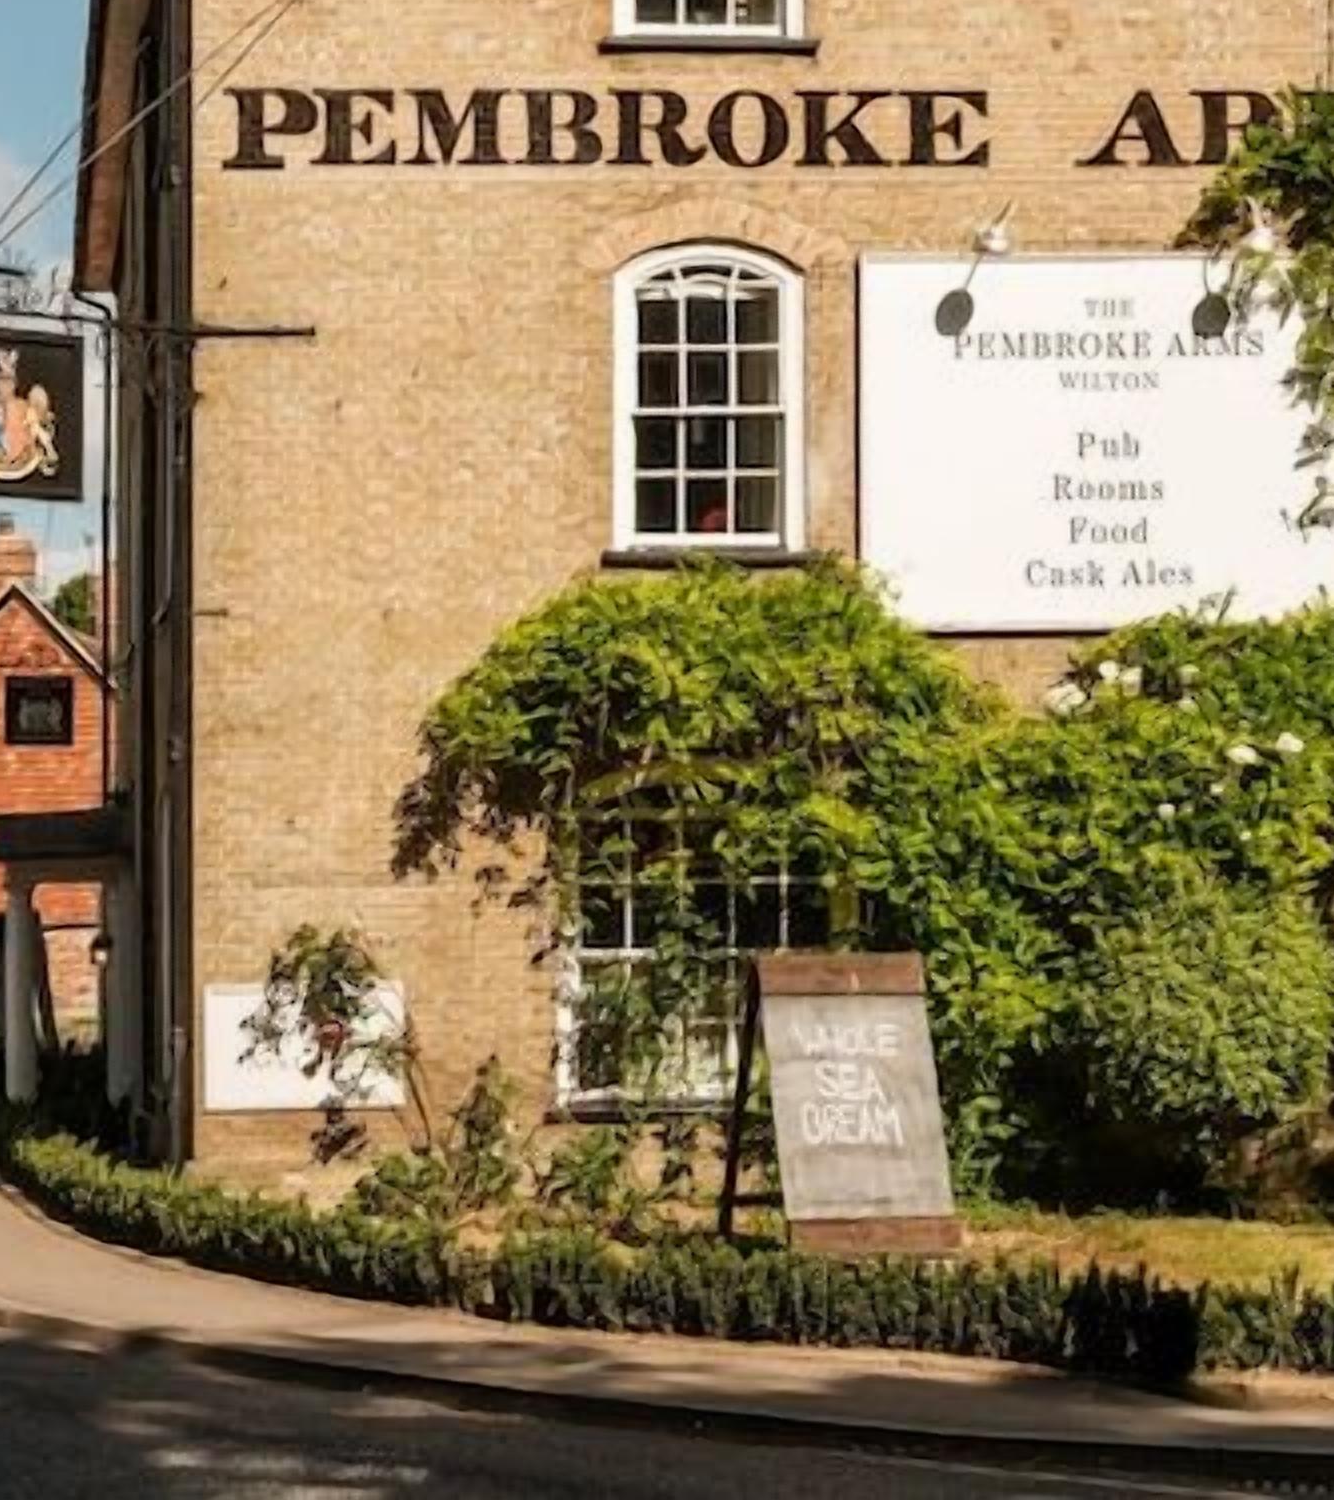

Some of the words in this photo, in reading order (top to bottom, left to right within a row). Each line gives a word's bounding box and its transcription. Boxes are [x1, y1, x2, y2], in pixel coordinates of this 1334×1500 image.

[221, 86, 989, 171] PEMBROKE
[1083, 298, 1134, 319] THE
[953, 331, 1152, 361] PEMBROKE
[1166, 329, 1265, 358] ARMS
[1058, 370, 1160, 391] WILTON
[1076, 431, 1142, 459] Pub
[1052, 473, 1165, 501] Rooms
[1068, 517, 1149, 545] Food
[1024, 560, 1105, 588] Cask
[1121, 560, 1195, 587] Ales
[814, 1060, 887, 1103] SEA
